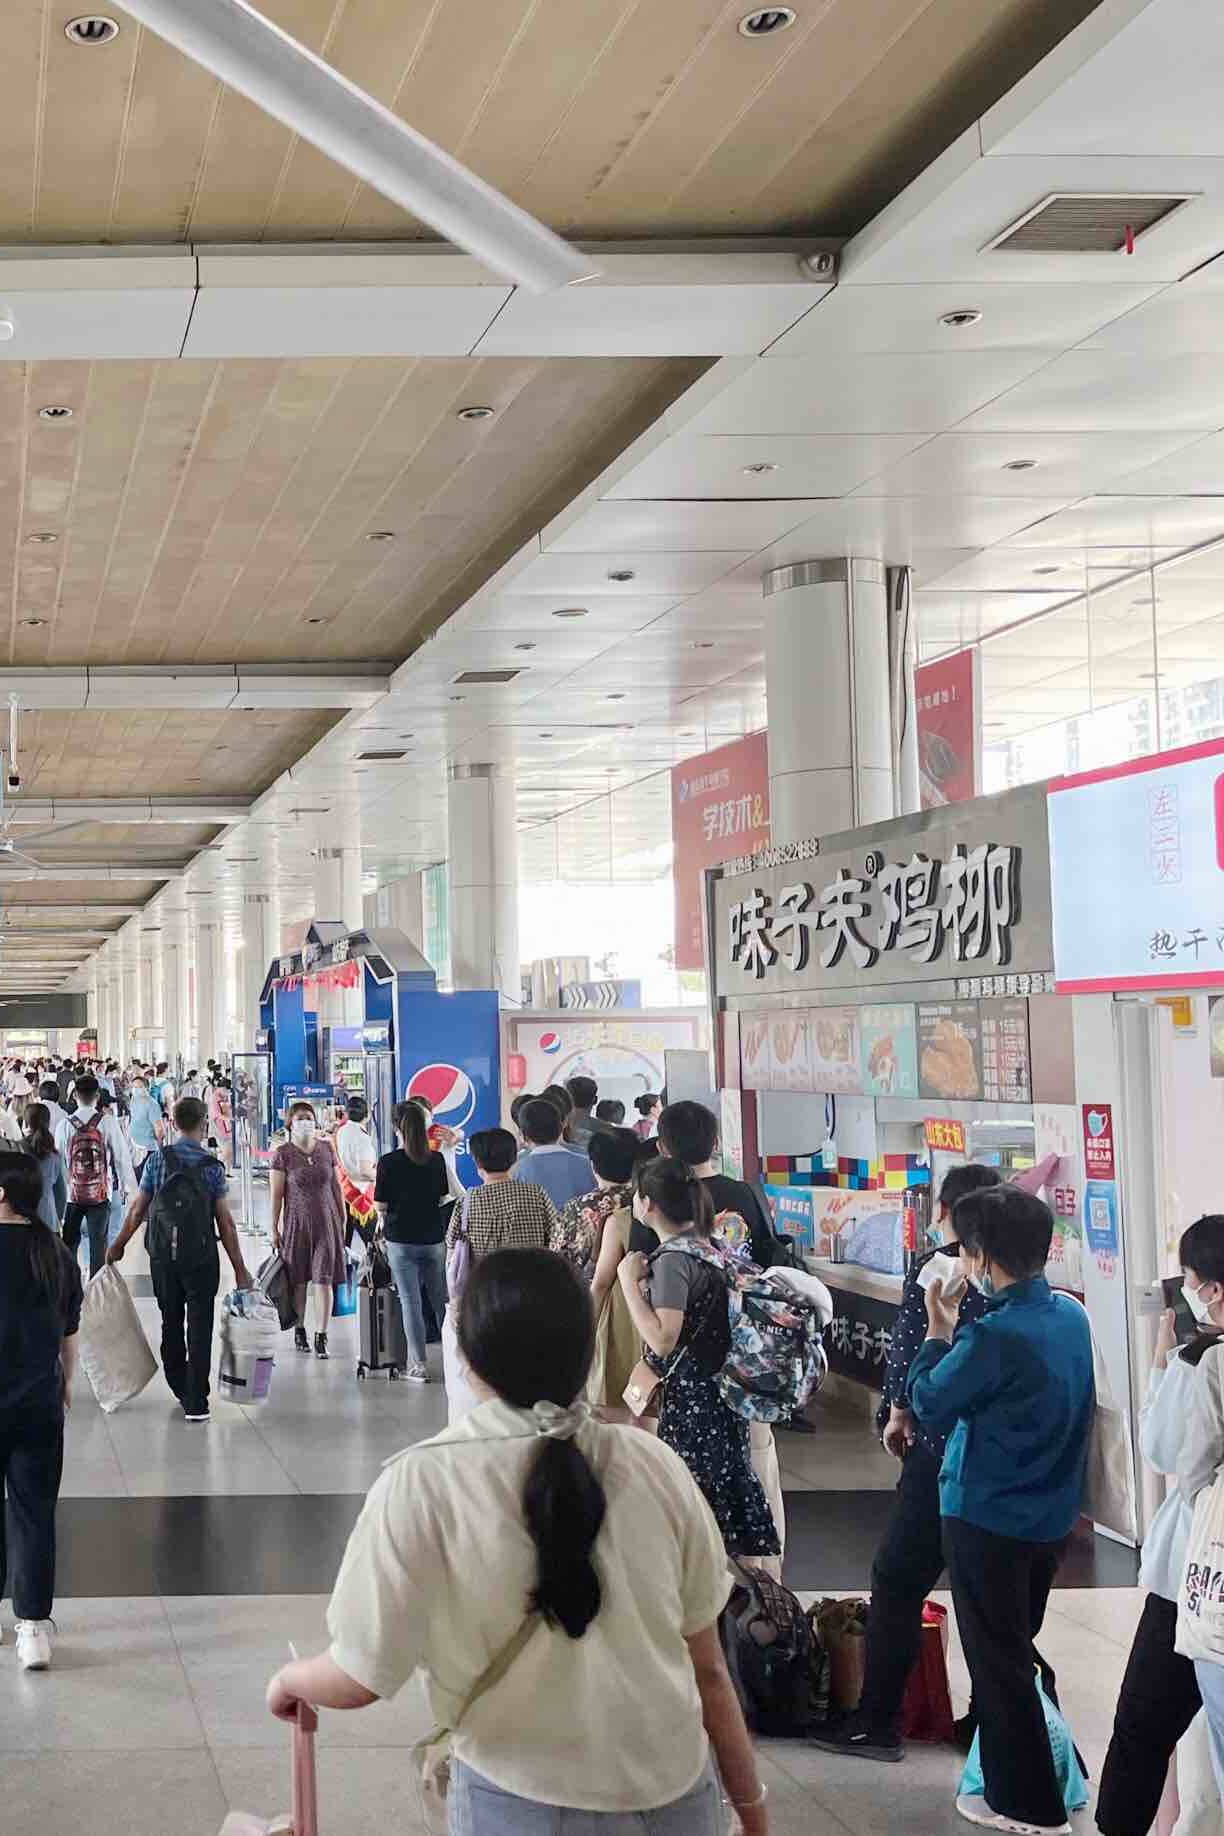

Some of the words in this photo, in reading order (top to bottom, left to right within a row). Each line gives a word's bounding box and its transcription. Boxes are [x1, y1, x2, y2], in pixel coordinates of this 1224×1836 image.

[703, 794, 769, 841] 学技术&
[1150, 926, 1224, 960] 热干
